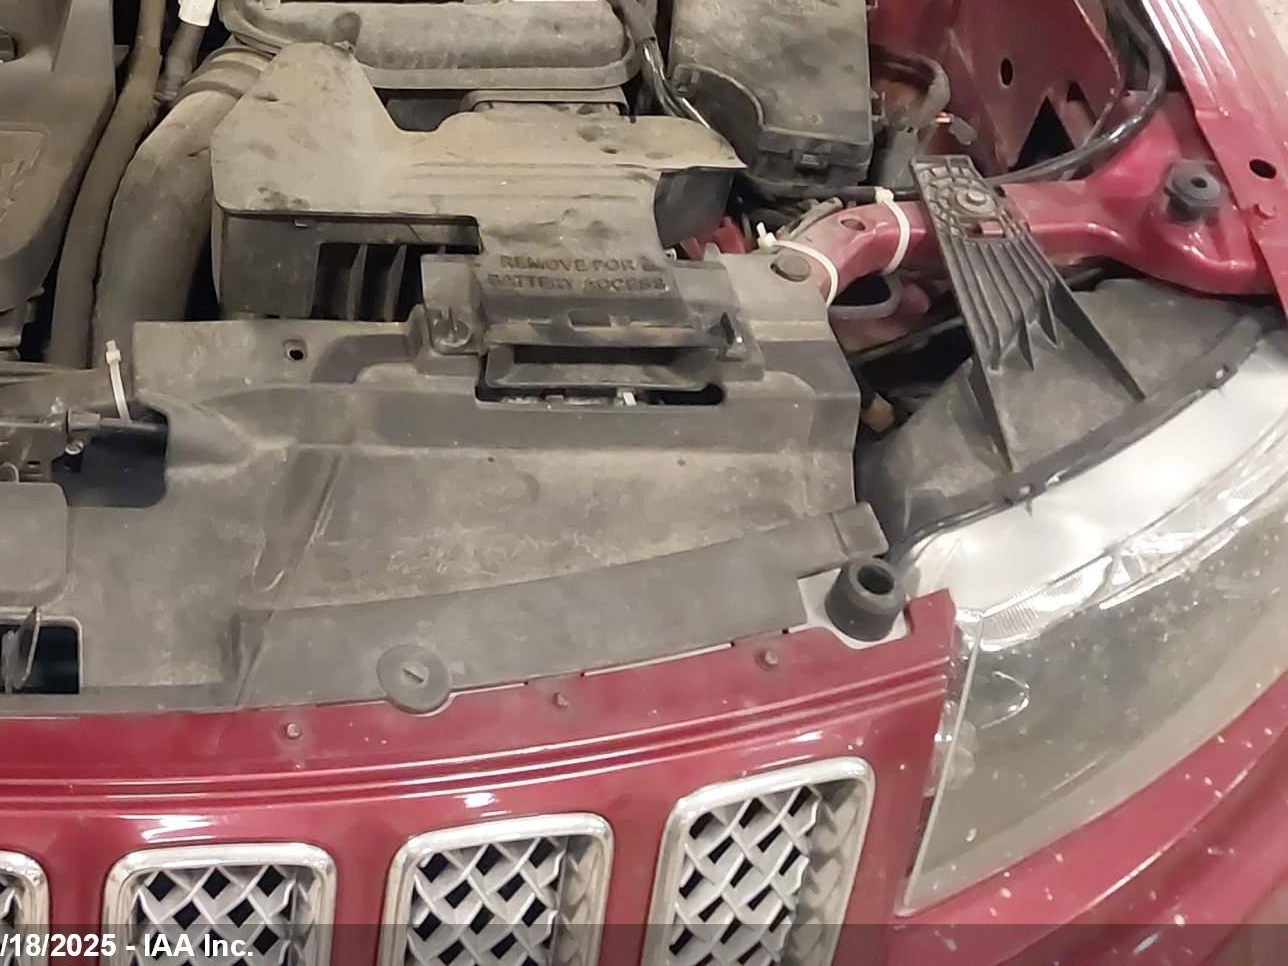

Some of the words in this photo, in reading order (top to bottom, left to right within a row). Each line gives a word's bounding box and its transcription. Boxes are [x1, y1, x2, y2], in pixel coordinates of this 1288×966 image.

[499, 255, 586, 272] REMOVE
[592, 258, 635, 272] FOR
[488, 273, 573, 290] BATTERY
[583, 276, 667, 291] ACCESS
